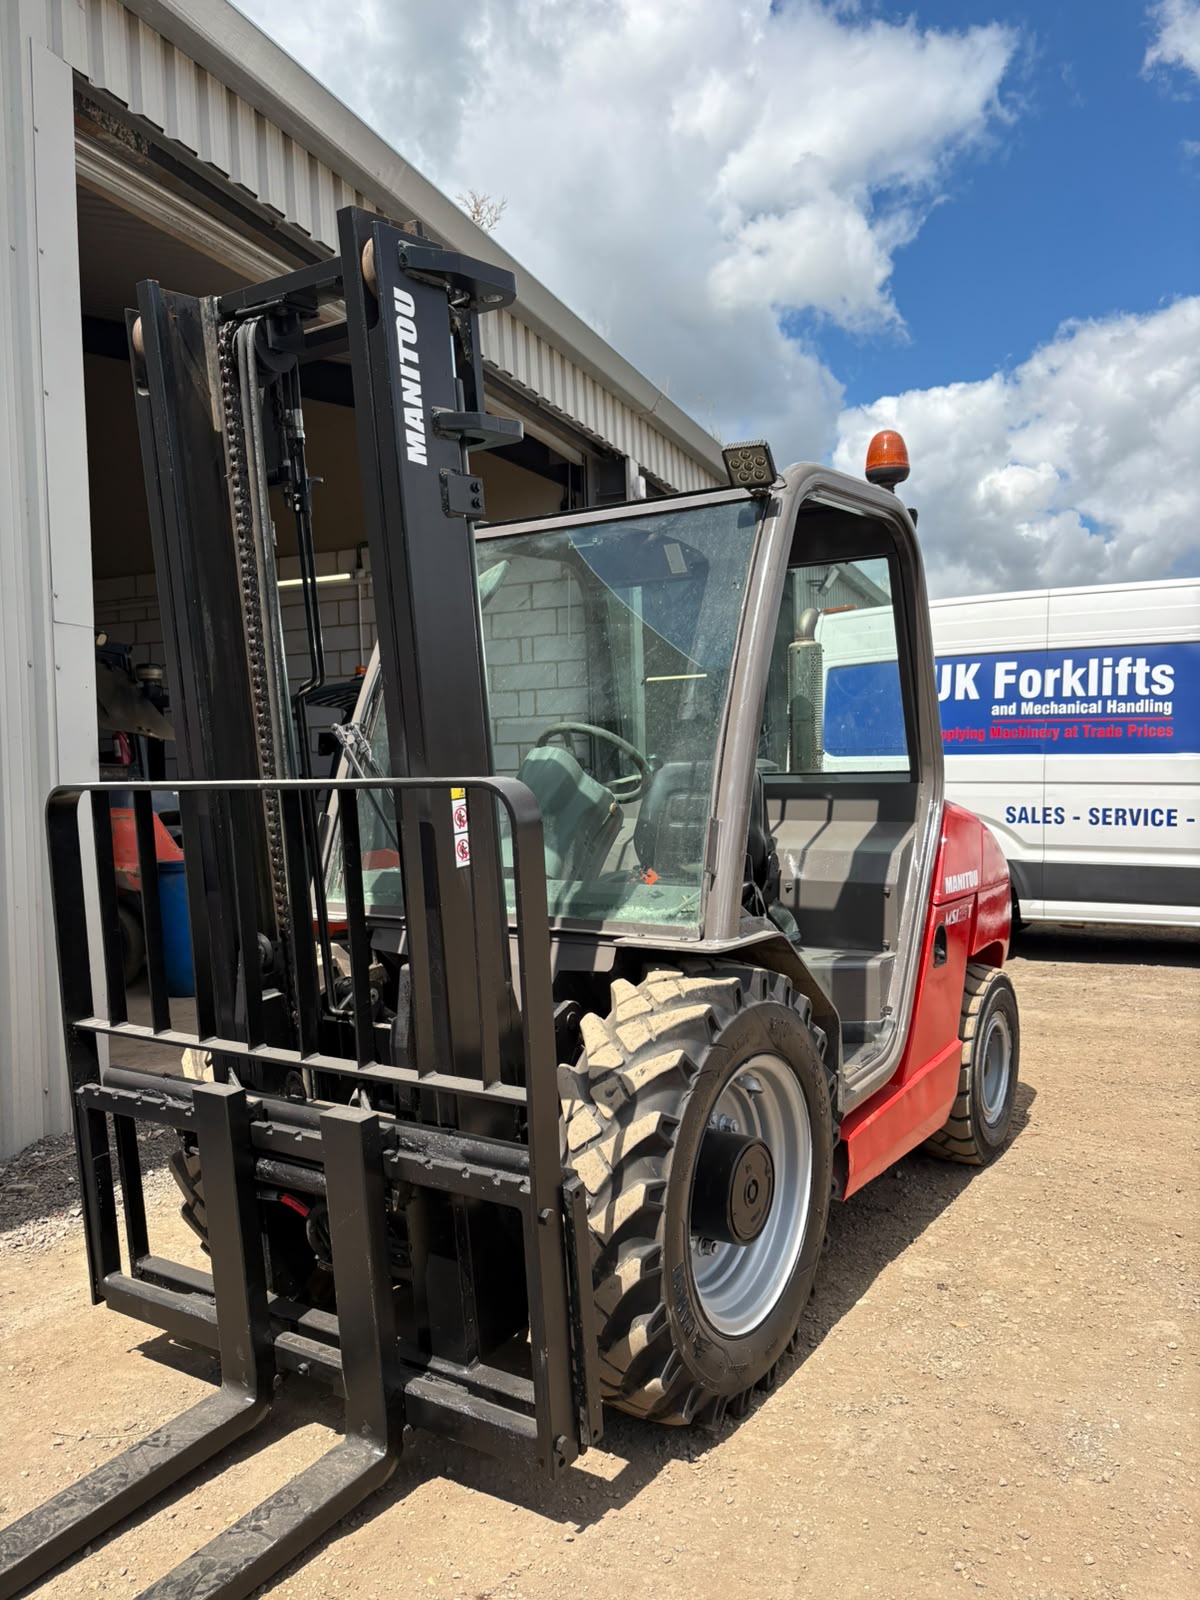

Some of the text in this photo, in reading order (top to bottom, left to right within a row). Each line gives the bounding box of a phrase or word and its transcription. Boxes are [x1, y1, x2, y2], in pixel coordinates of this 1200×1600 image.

[393, 286, 428, 466] MANITOU
[994, 657, 1175, 699] Forklifts
[991, 699, 1172, 716] and Mechanical Handling
[990, 726, 1060, 741] Machinery
[1064, 726, 1079, 738] at
[1083, 725, 1122, 738] Trade
[1127, 724, 1173, 738] Prices
[1005, 806, 1065, 825] SALES
[1088, 807, 1178, 827] SERVICE
[945, 870, 979, 894] MANITOU
